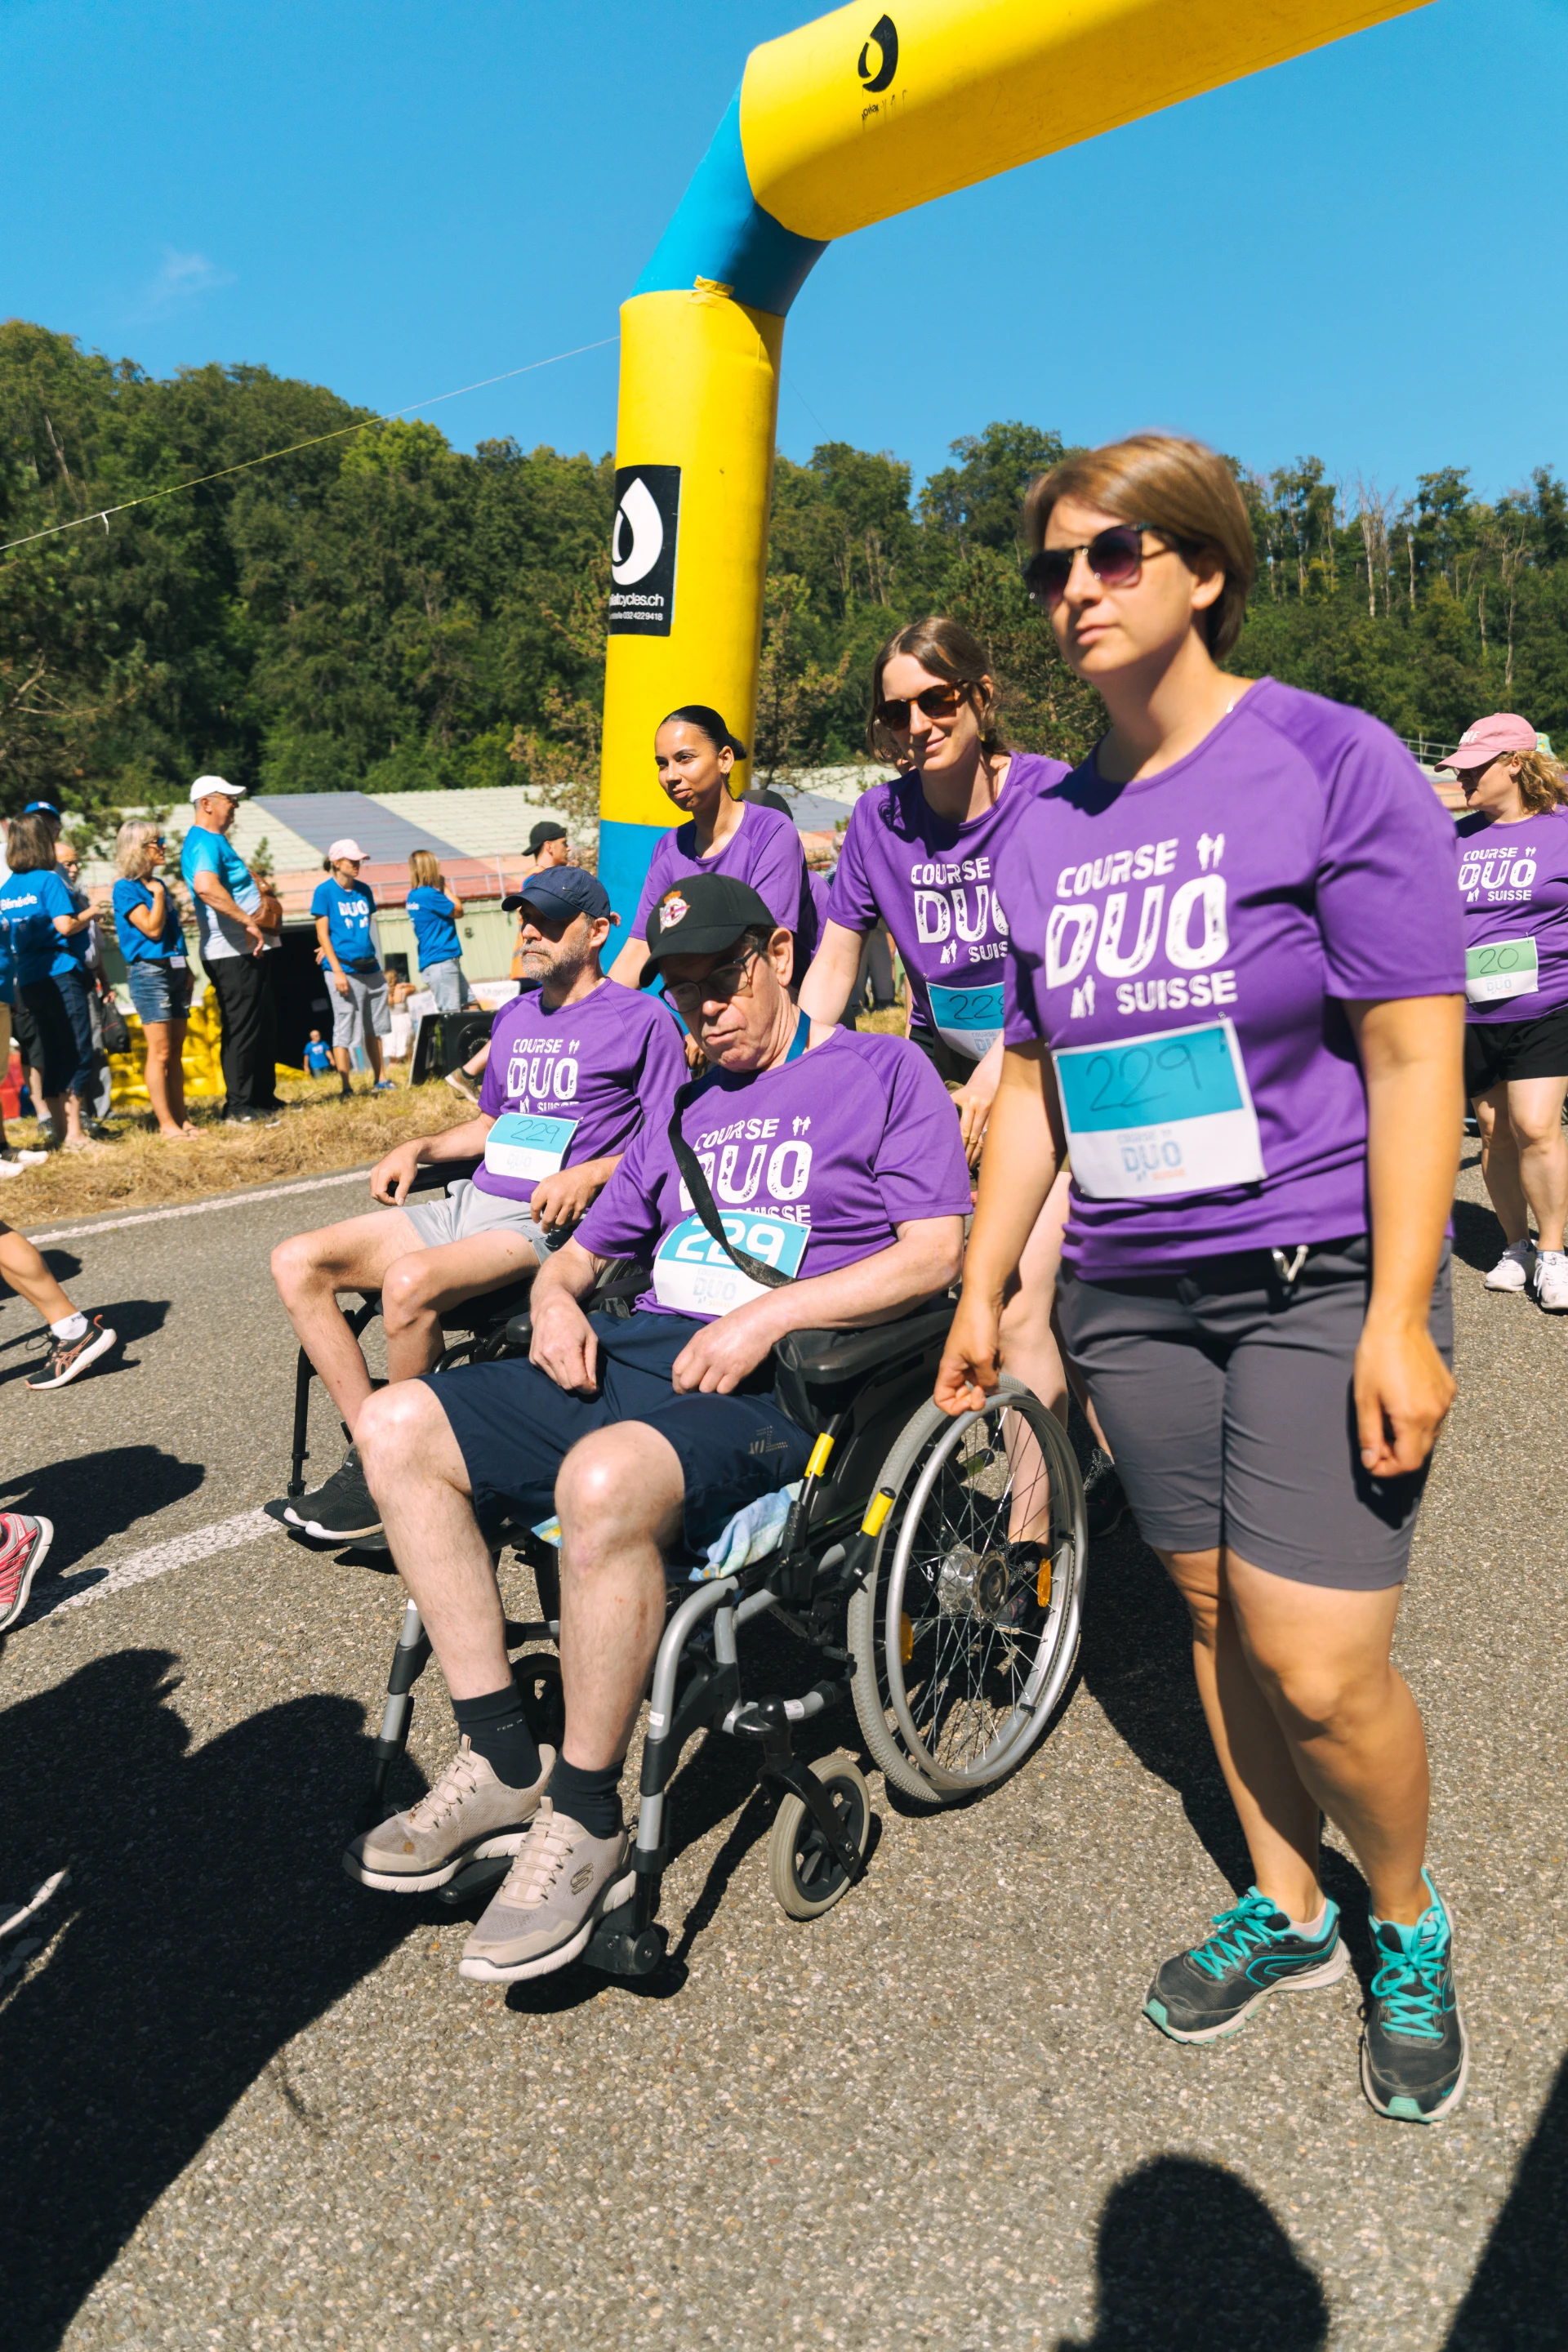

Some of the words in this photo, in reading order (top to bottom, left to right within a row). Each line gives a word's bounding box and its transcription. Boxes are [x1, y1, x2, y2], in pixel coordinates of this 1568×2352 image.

[1057, 838, 1178, 898] COURSE
[1463, 847, 1518, 862] COURSE
[911, 858, 991, 884] COURSE
[1458, 859, 1537, 890] DUO
[338, 900, 369, 916] DUO
[1487, 890, 1532, 902] SUISSE
[1045, 874, 1229, 990] DUO
[969, 942, 1009, 962] SUIS
[1479, 948, 1518, 973] 20
[1116, 969, 1238, 1014] SUISSE
[513, 1039, 564, 1054] COURSE
[507, 1058, 578, 1099] DUO
[1086, 1044, 1201, 1111] 229
[510, 1120, 559, 1143] 229
[693, 1118, 779, 1152] COURSE
[1120, 1141, 1182, 1172] DUO
[675, 1218, 785, 1267] 229
[693, 1277, 737, 1300] DUO
